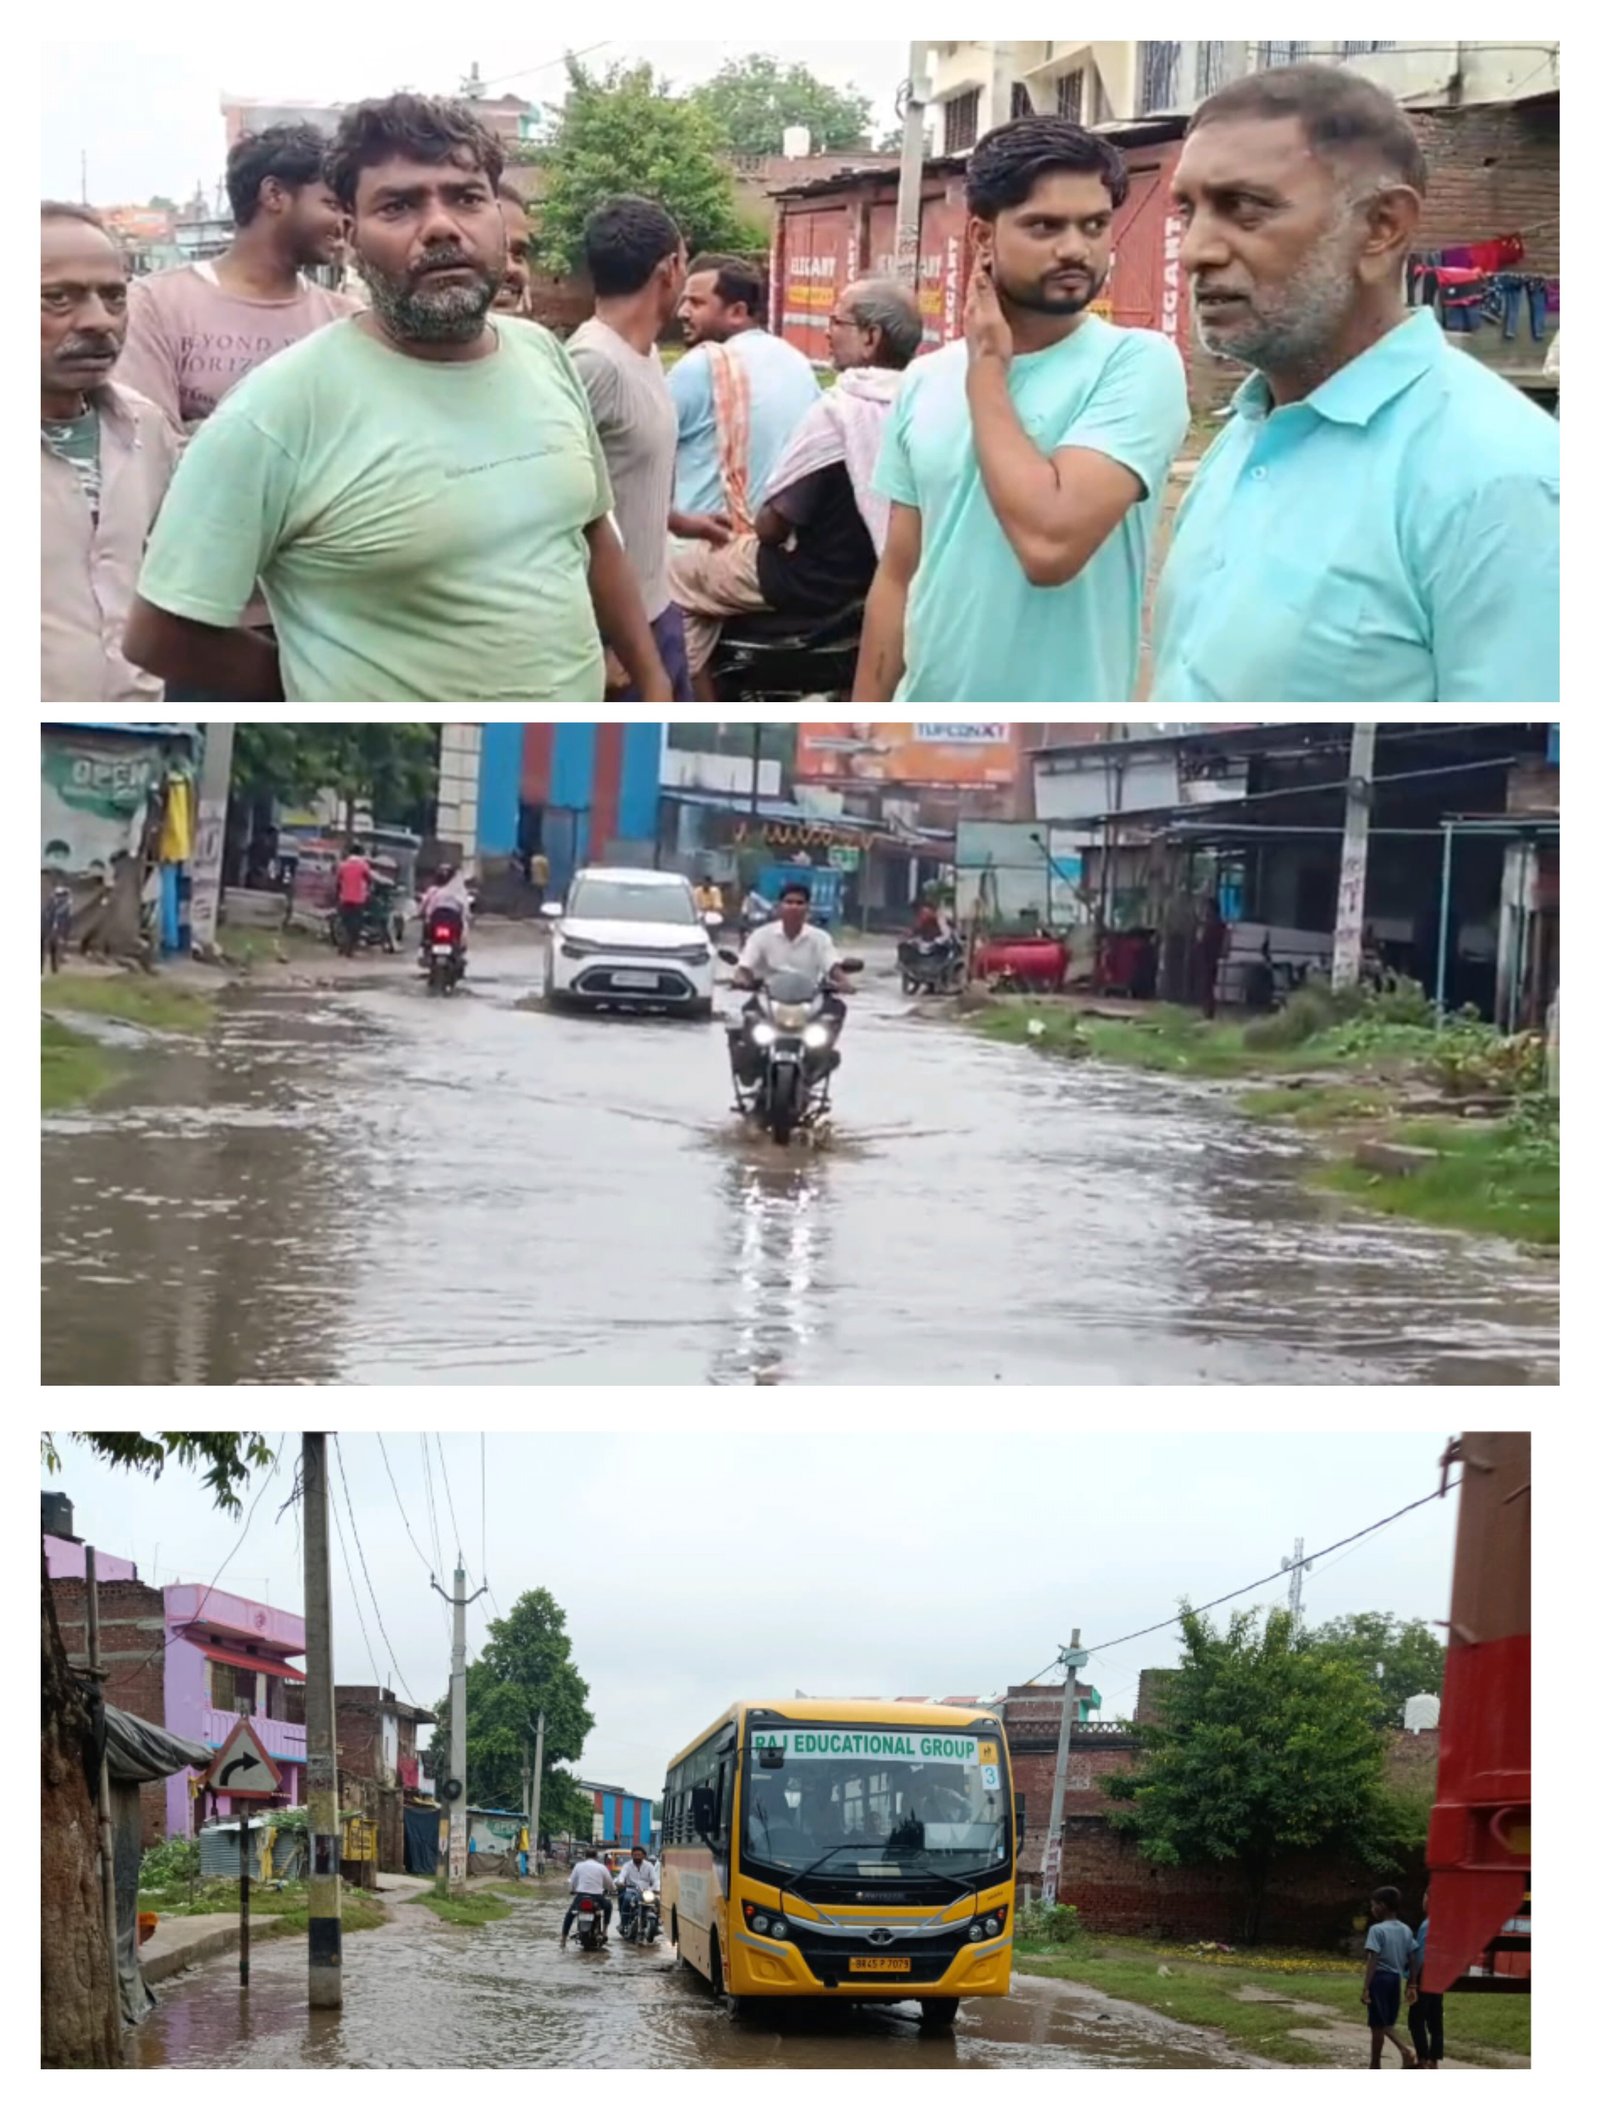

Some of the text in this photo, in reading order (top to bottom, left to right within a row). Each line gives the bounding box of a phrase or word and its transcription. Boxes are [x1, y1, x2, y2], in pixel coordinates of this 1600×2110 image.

[794, 1734, 915, 1755] EDUCATIONAL
[920, 1737, 975, 1759] GROUP
[984, 1767, 996, 1785] 3
